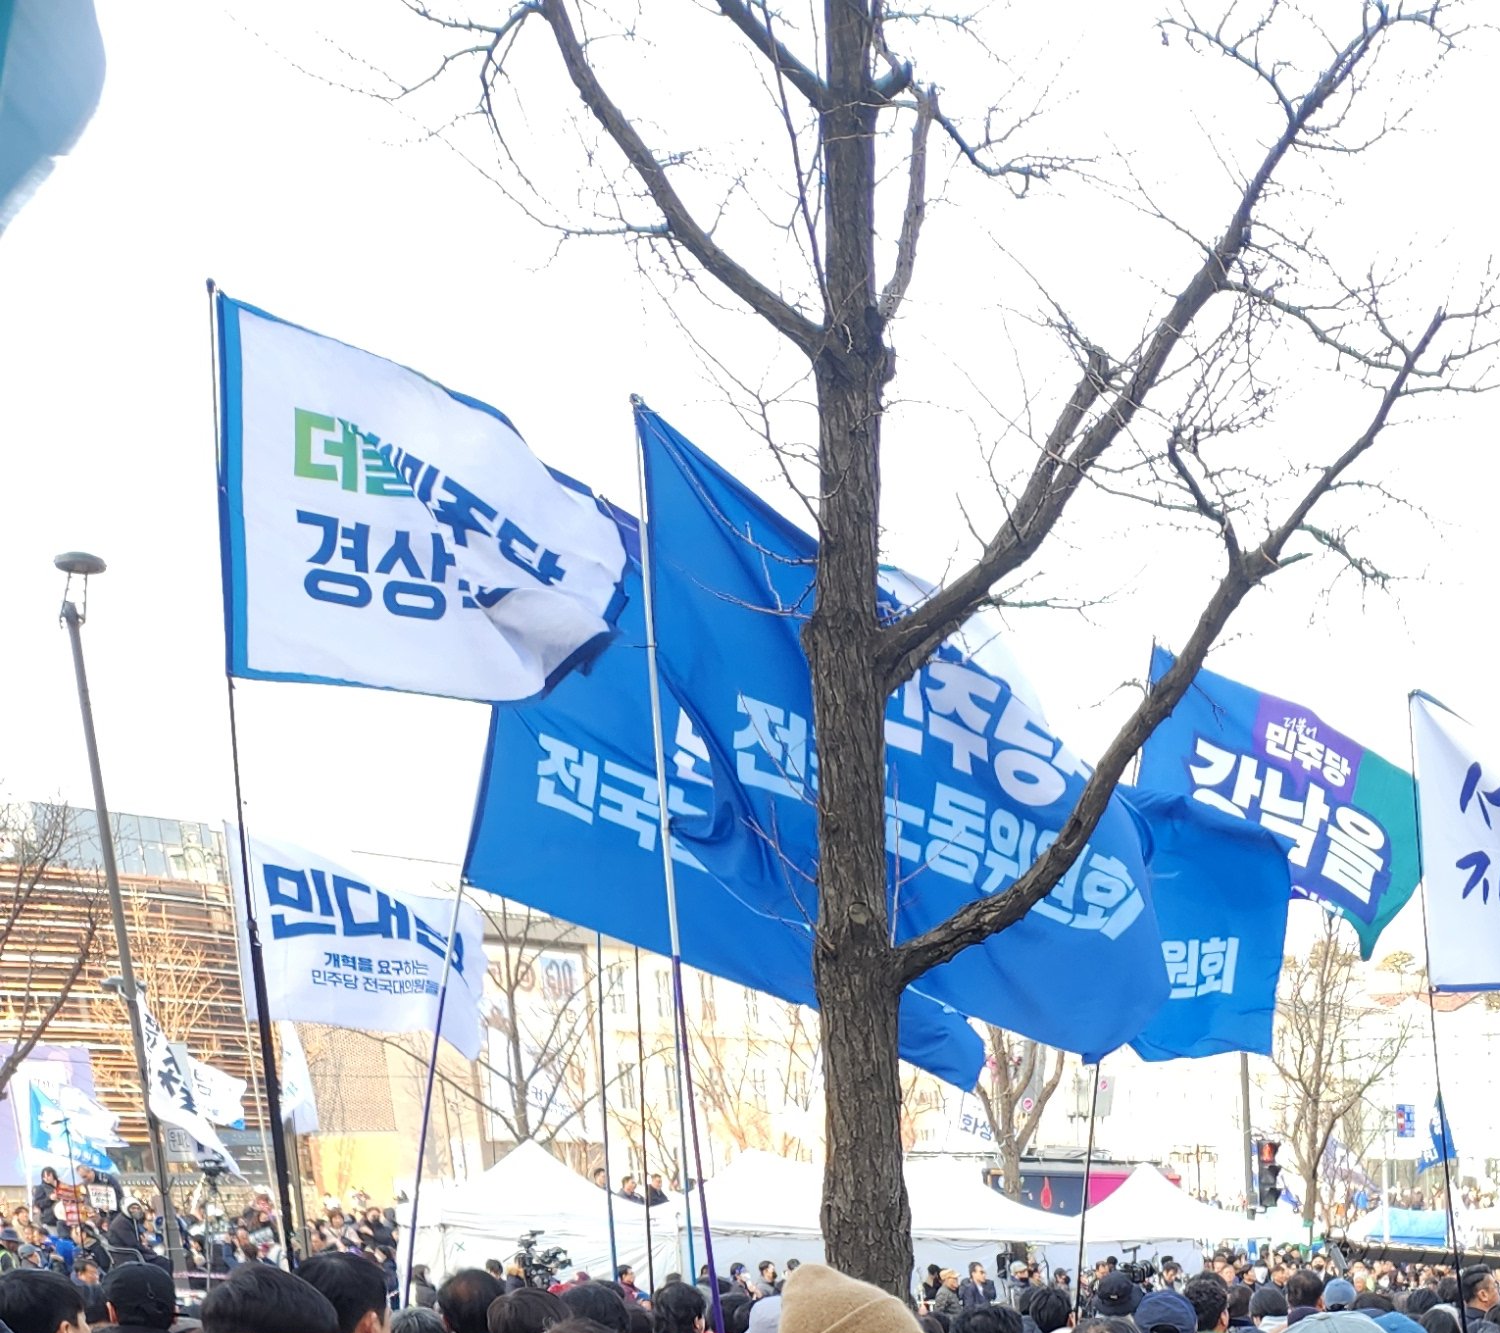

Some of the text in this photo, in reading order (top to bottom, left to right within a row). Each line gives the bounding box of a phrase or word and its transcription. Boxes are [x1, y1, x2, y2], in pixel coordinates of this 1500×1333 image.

[1265, 722, 1352, 788] 민주당
[1188, 736, 1386, 905] 강남을
[311, 969, 358, 990] 민주당
[323, 951, 430, 977] 개혁을 요구하는
